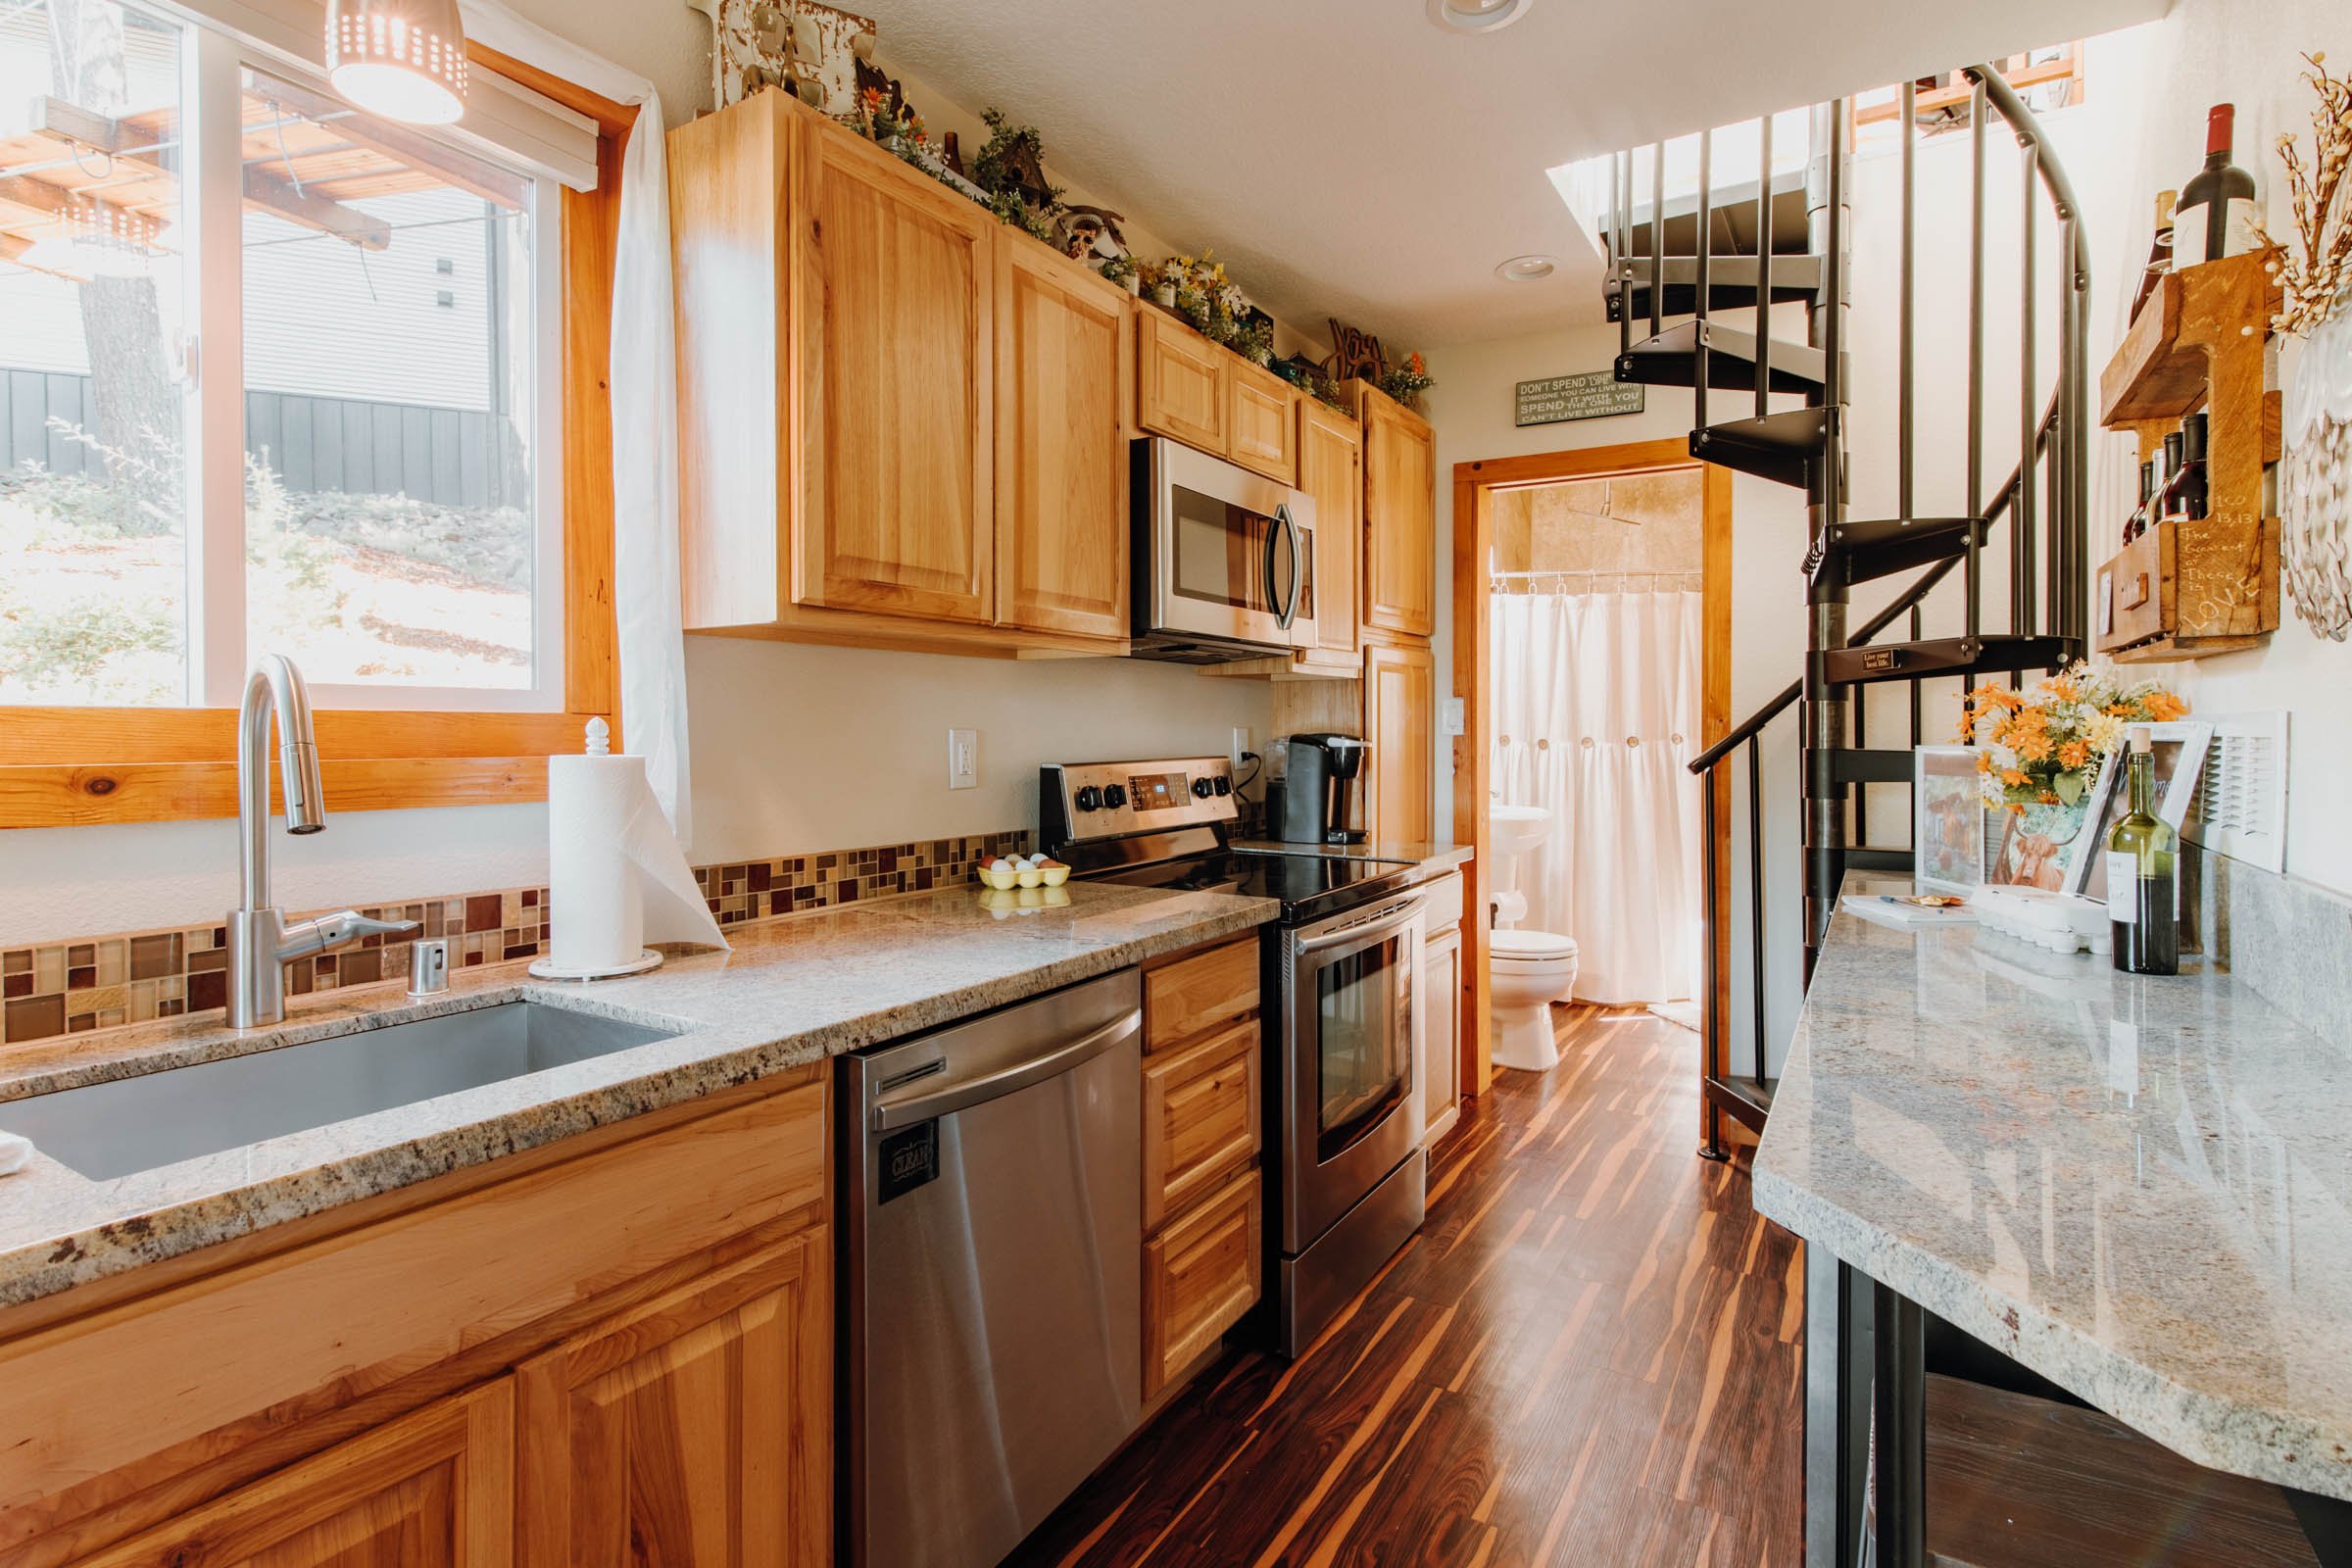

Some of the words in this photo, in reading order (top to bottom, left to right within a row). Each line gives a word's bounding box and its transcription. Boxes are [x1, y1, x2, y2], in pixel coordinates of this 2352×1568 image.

[1520, 382, 1550, 395] DON'T
[1552, 377, 1586, 391] SPEND
[1588, 372, 1612, 381] YOUR
[1520, 392, 1559, 402] SOMEONE
[1561, 389, 1578, 398] YOU
[1583, 392, 1610, 402] WITH
[1615, 391, 1639, 401] YOU
[1520, 400, 1564, 415] SPEND
[1567, 401, 1588, 410] THE
[1591, 398, 1613, 407] ONE
[1522, 413, 1554, 423] CAN'T
[1558, 410, 1584, 418] LIVE
[2180, 527, 2211, 541] The
[2182, 575, 2261, 630] LOVE
